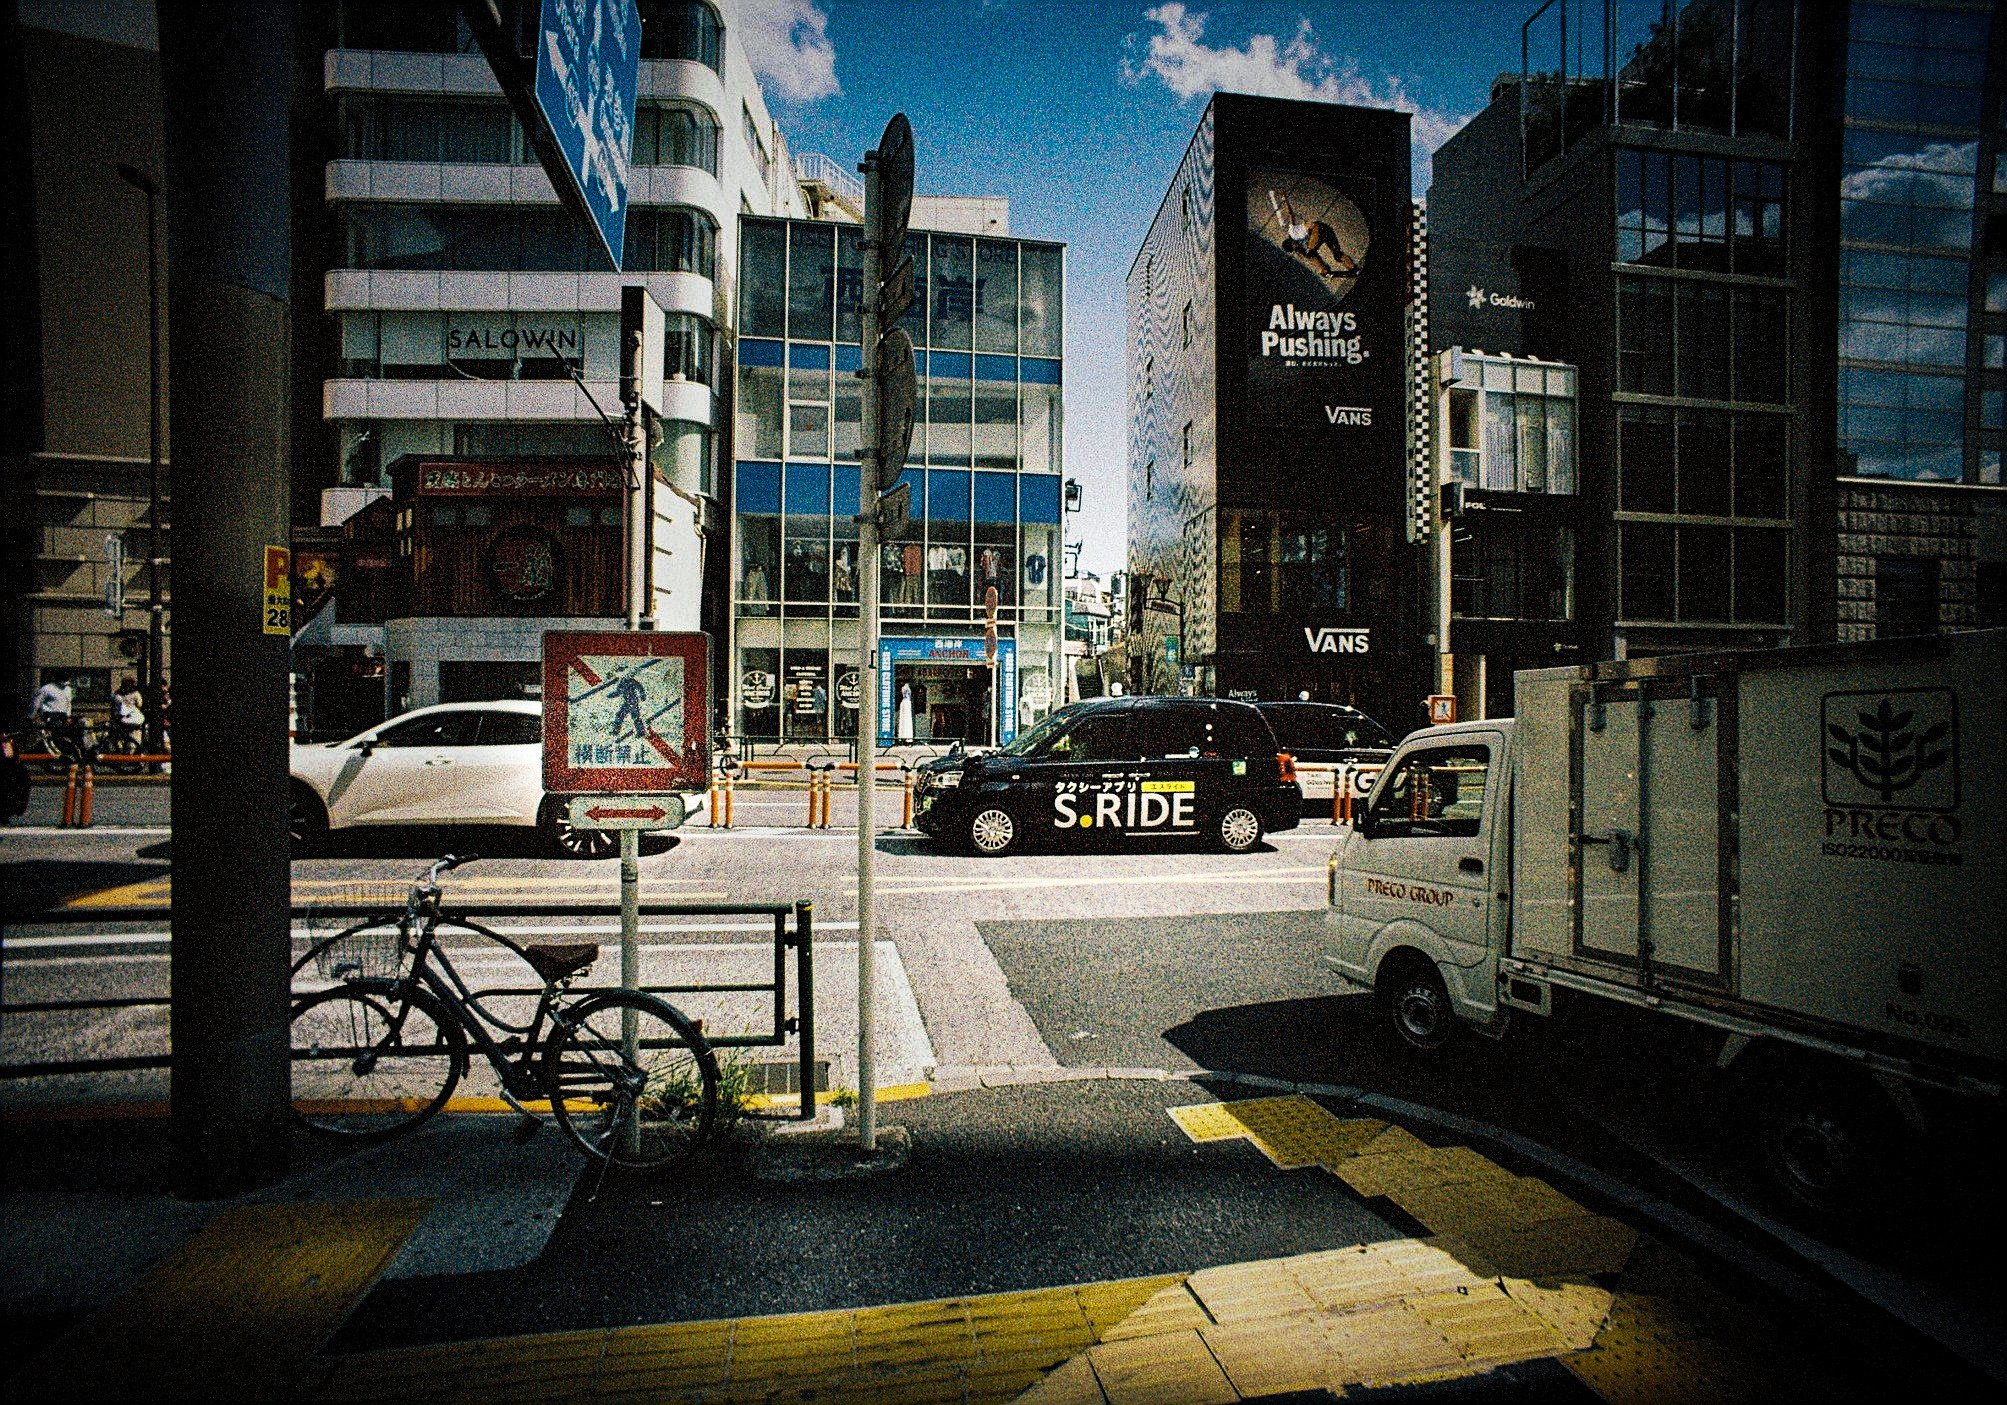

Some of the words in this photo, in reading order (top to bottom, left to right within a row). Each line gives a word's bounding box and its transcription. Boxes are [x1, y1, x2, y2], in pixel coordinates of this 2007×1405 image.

[1490, 292, 1537, 311] Goldwin
[1269, 303, 1357, 337] Always
[450, 328, 576, 349] SALOWIN
[1261, 331, 1370, 364] Pushing.
[1325, 405, 1372, 426] VANS
[268, 548, 289, 588] P
[267, 608, 288, 628] 28
[1304, 627, 1370, 653] VANS
[574, 743, 651, 765] 横断禁止
[1055, 781, 1137, 793] タクシーアプリ
[1054, 793, 1195, 828] S.RIDE
[1823, 809, 1962, 846] PRECO
[1367, 878, 1406, 899] PRECO
[1410, 886, 1455, 907] GROUP
